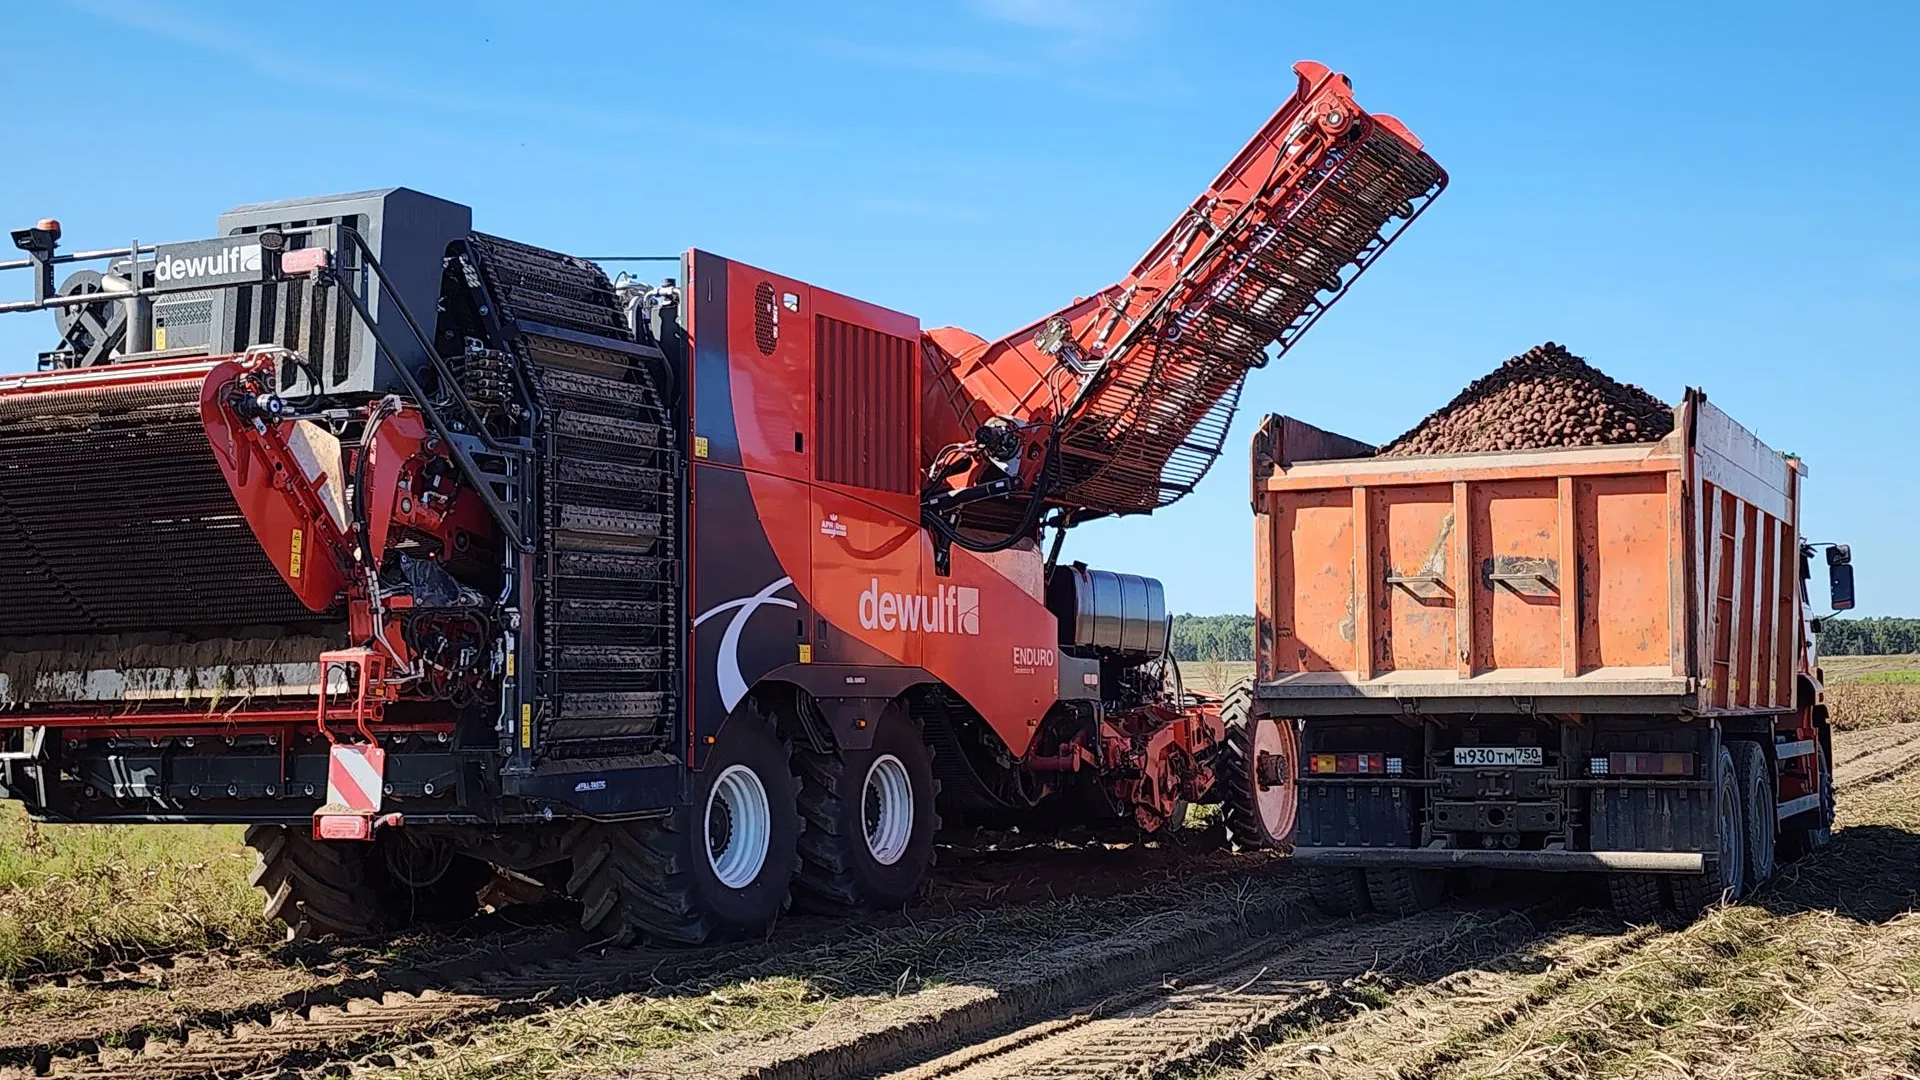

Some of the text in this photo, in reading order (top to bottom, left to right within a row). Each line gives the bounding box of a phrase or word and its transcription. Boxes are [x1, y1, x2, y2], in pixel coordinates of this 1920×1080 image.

[155, 246, 240, 282] dewulf
[859, 578, 956, 633] dewulf
[1013, 647, 1054, 667] ENDURO
[1516, 748, 1538, 759] 750
